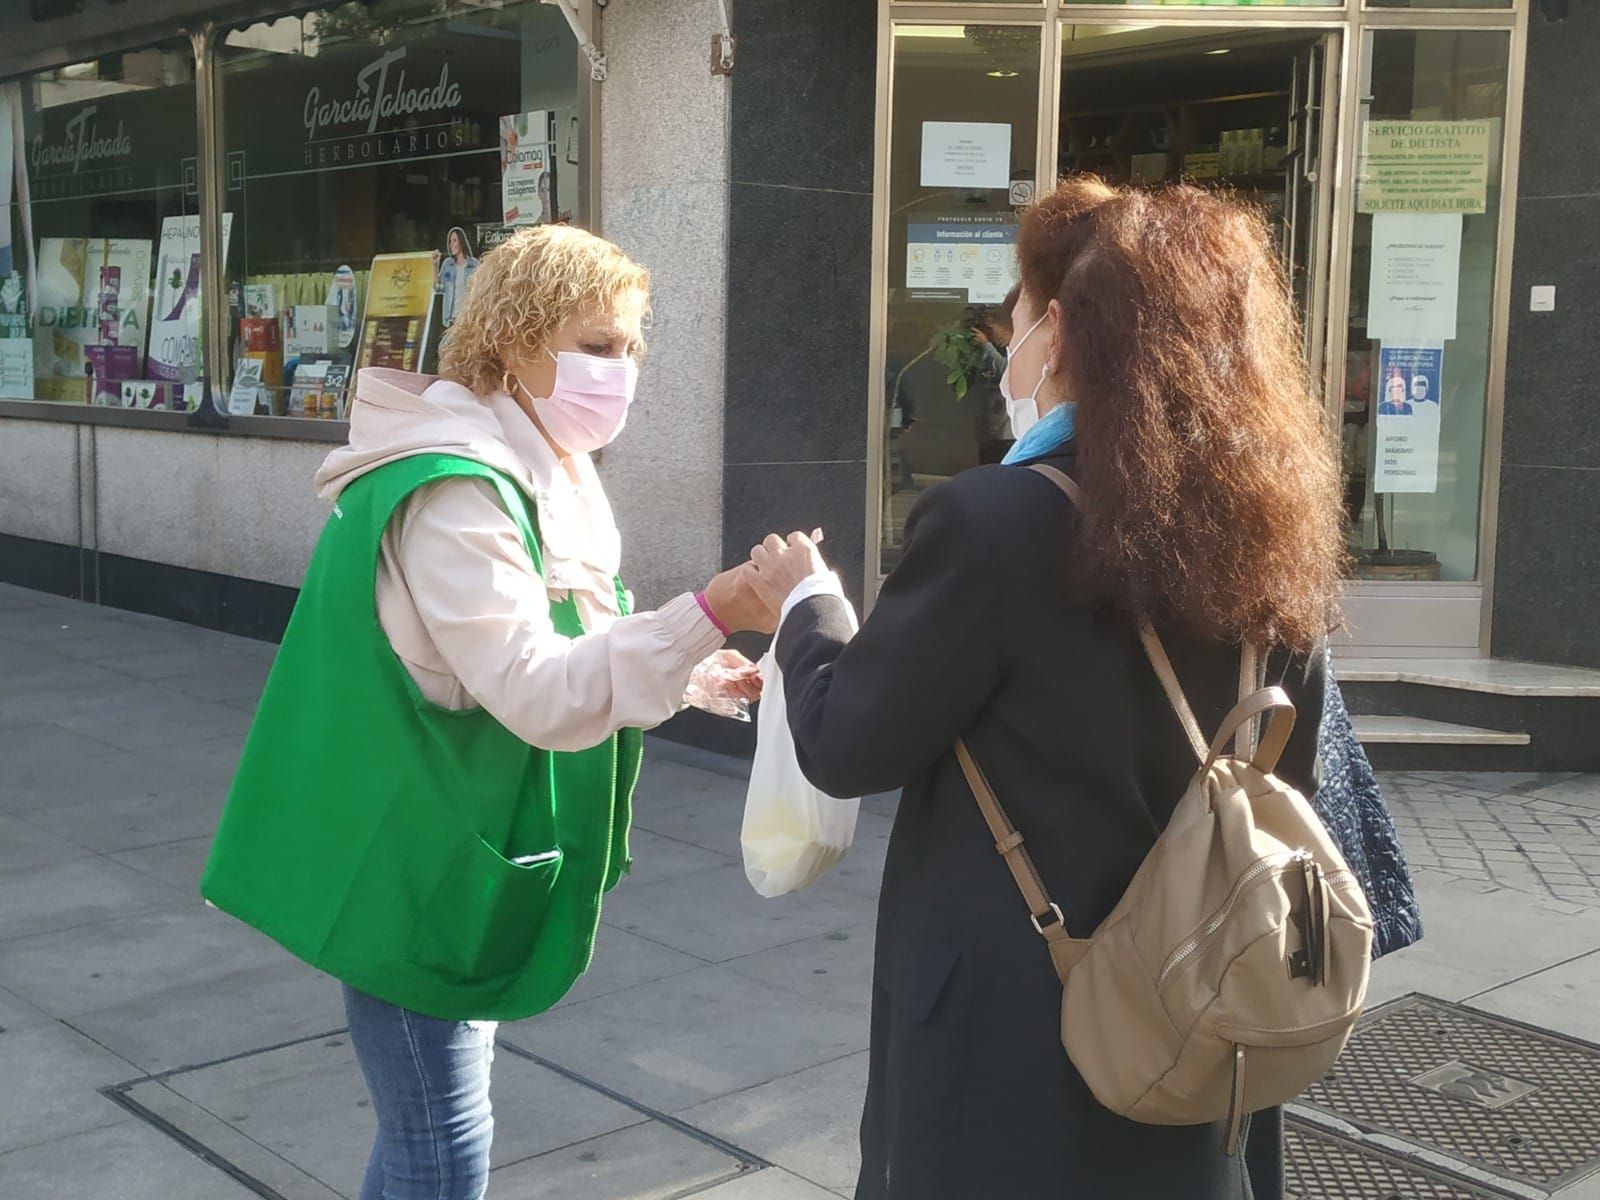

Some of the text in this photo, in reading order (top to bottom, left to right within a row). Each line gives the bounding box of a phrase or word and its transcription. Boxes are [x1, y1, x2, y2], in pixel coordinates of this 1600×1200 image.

[305, 47, 463, 139] García Taboada
[1369, 125, 1485, 136] SERVICIO GRATUITO
[305, 132, 464, 164] HERBOLARIOS
[1391, 138, 1461, 149] DE DIETISTA
[1364, 199, 1407, 209] SOLICITE
[1456, 198, 1481, 209] HORA
[936, 229, 1004, 238] Información al cliente
[40, 306, 140, 329] DIETIA
[325, 375, 343, 387] 3x2
